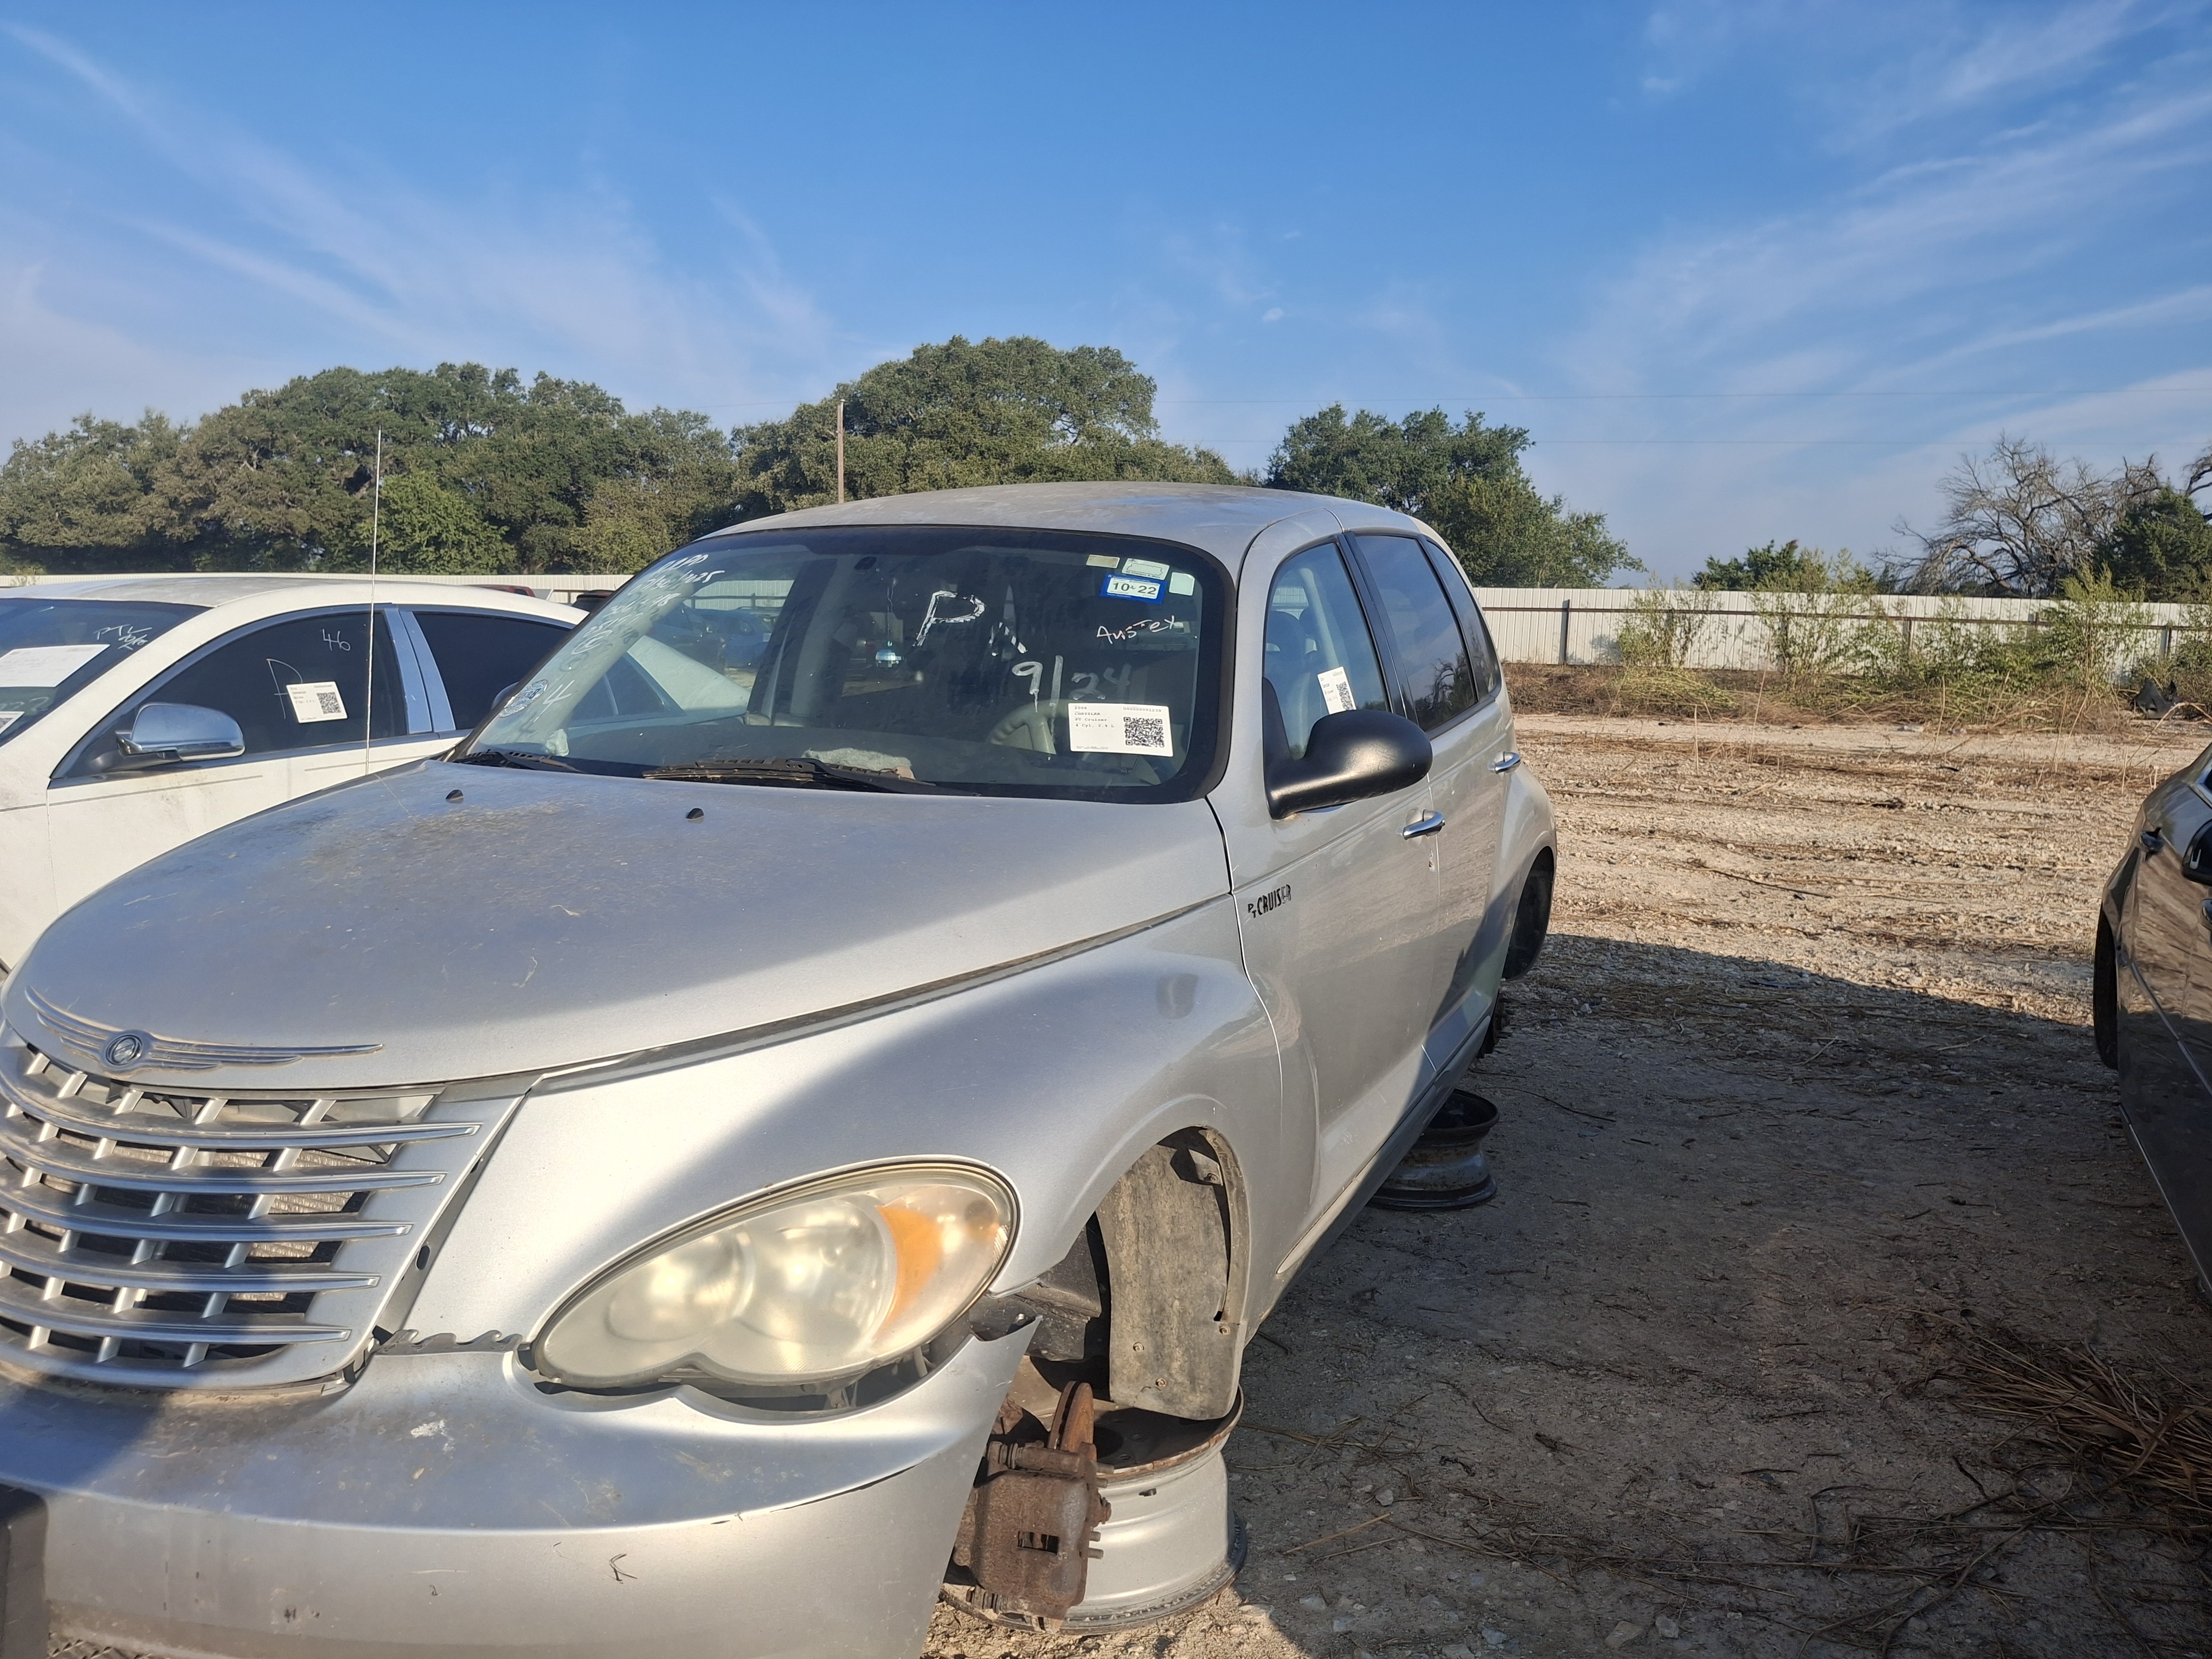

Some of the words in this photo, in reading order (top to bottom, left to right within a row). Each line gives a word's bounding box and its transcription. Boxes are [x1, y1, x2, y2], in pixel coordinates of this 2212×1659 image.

[1113, 582, 1130, 591] 10
[1137, 585, 1157, 595] 22
[322, 628, 351, 651] 46
[1257, 884, 1291, 916] CRUISER
